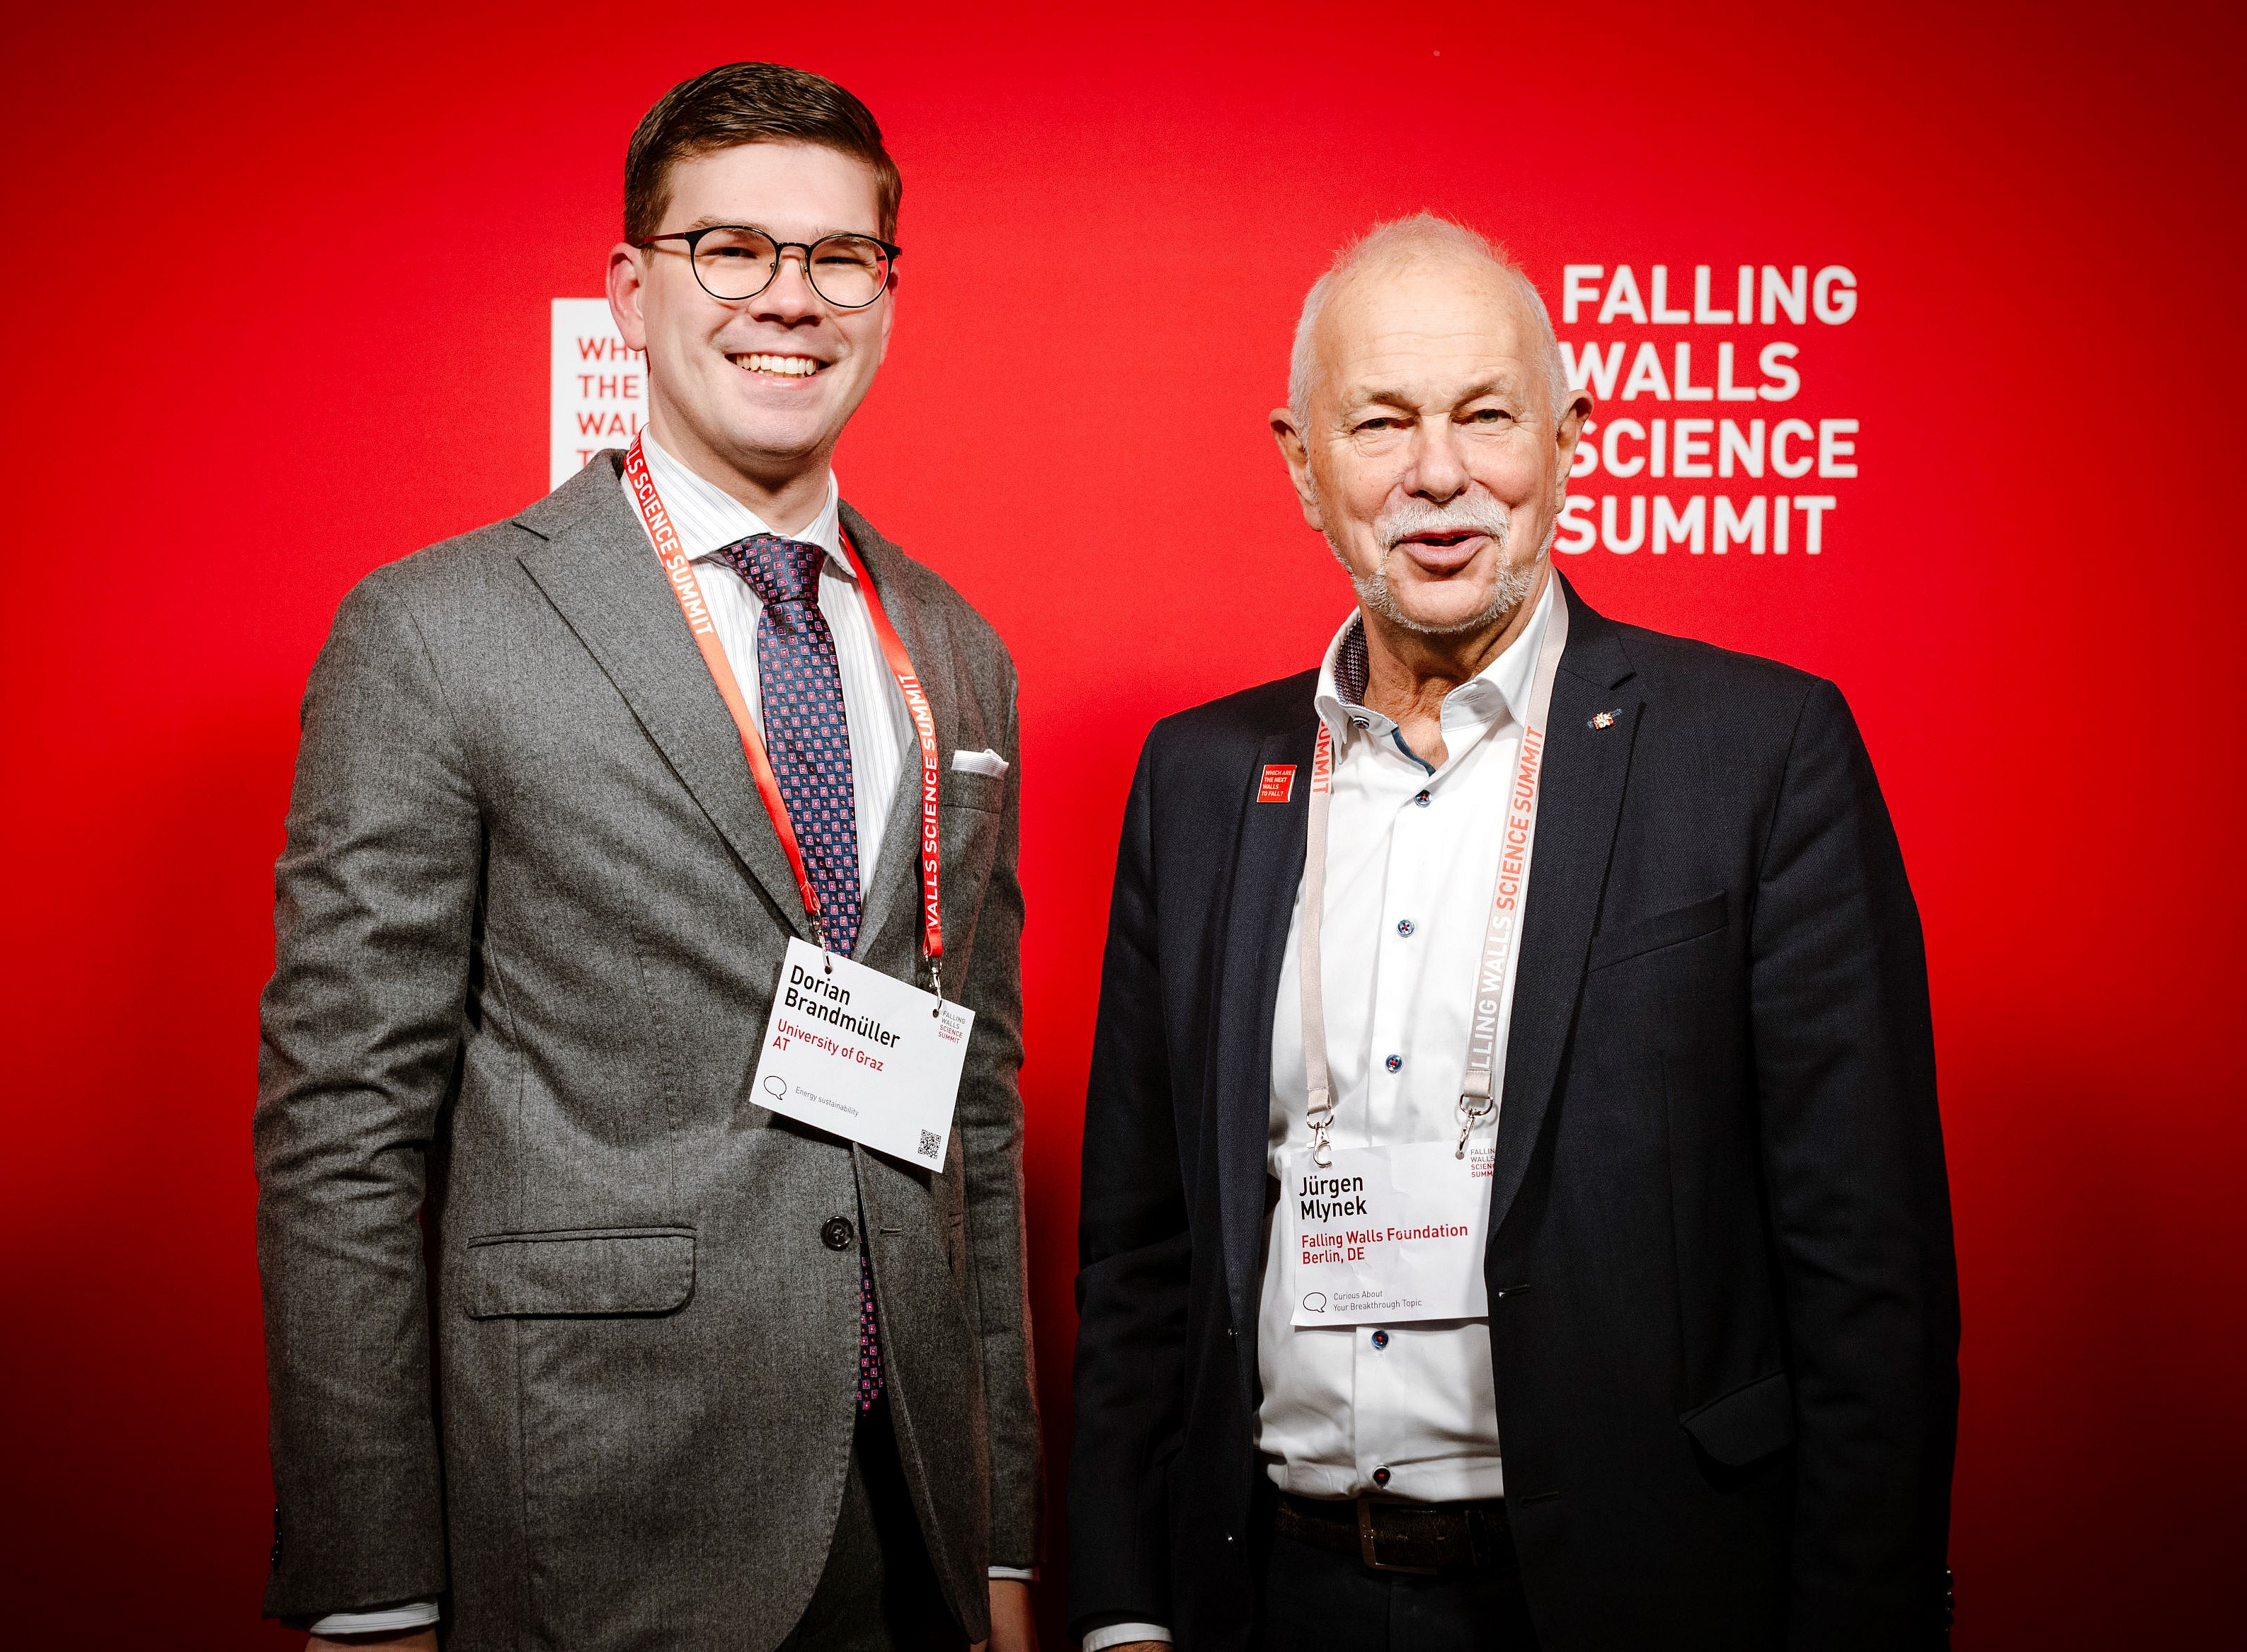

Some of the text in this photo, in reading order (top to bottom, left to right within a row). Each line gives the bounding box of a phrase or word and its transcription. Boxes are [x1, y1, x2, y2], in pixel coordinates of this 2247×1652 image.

[1562, 265, 1858, 326] FALLING
[578, 374, 639, 398] THE
[1558, 342, 1801, 402] WALLS
[1569, 418, 1860, 479] SCIENCE
[1555, 495, 1837, 556] SUMMIT
[634, 472, 678, 556] SCIENCE
[666, 555, 714, 635] SUMMIT
[898, 674, 935, 751] SUMMIT
[1313, 721, 1331, 793] UMMIT
[1513, 725, 1544, 813] SUMMIT
[924, 756, 937, 854] SCIENCE
[1496, 815, 1529, 912] SCIENCE
[1481, 914, 1512, 993] WALLS
[790, 965, 850, 1005] Dorian
[784, 987, 900, 1048] Brandmüller
[938, 1031, 960, 1044] SUMMIT
[939, 1024, 964, 1038] SCIENCE
[942, 1011, 966, 1024] FALLING
[942, 1017, 960, 1030] WALLS
[772, 1036, 791, 1051] AT
[777, 1019, 884, 1072] University of Graz
[795, 1086, 859, 1118] Energy sustainability
[1298, 1175, 1363, 1199] Jürgen
[1300, 1195, 1368, 1223] Mlynek
[1302, 1224, 1468, 1248] Falling Walls Foundation
[1302, 1247, 1365, 1264] Berlin, DE
[1333, 1298, 1422, 1312] Your Breakthrough Topic
[1334, 1290, 1383, 1301] Curious About
